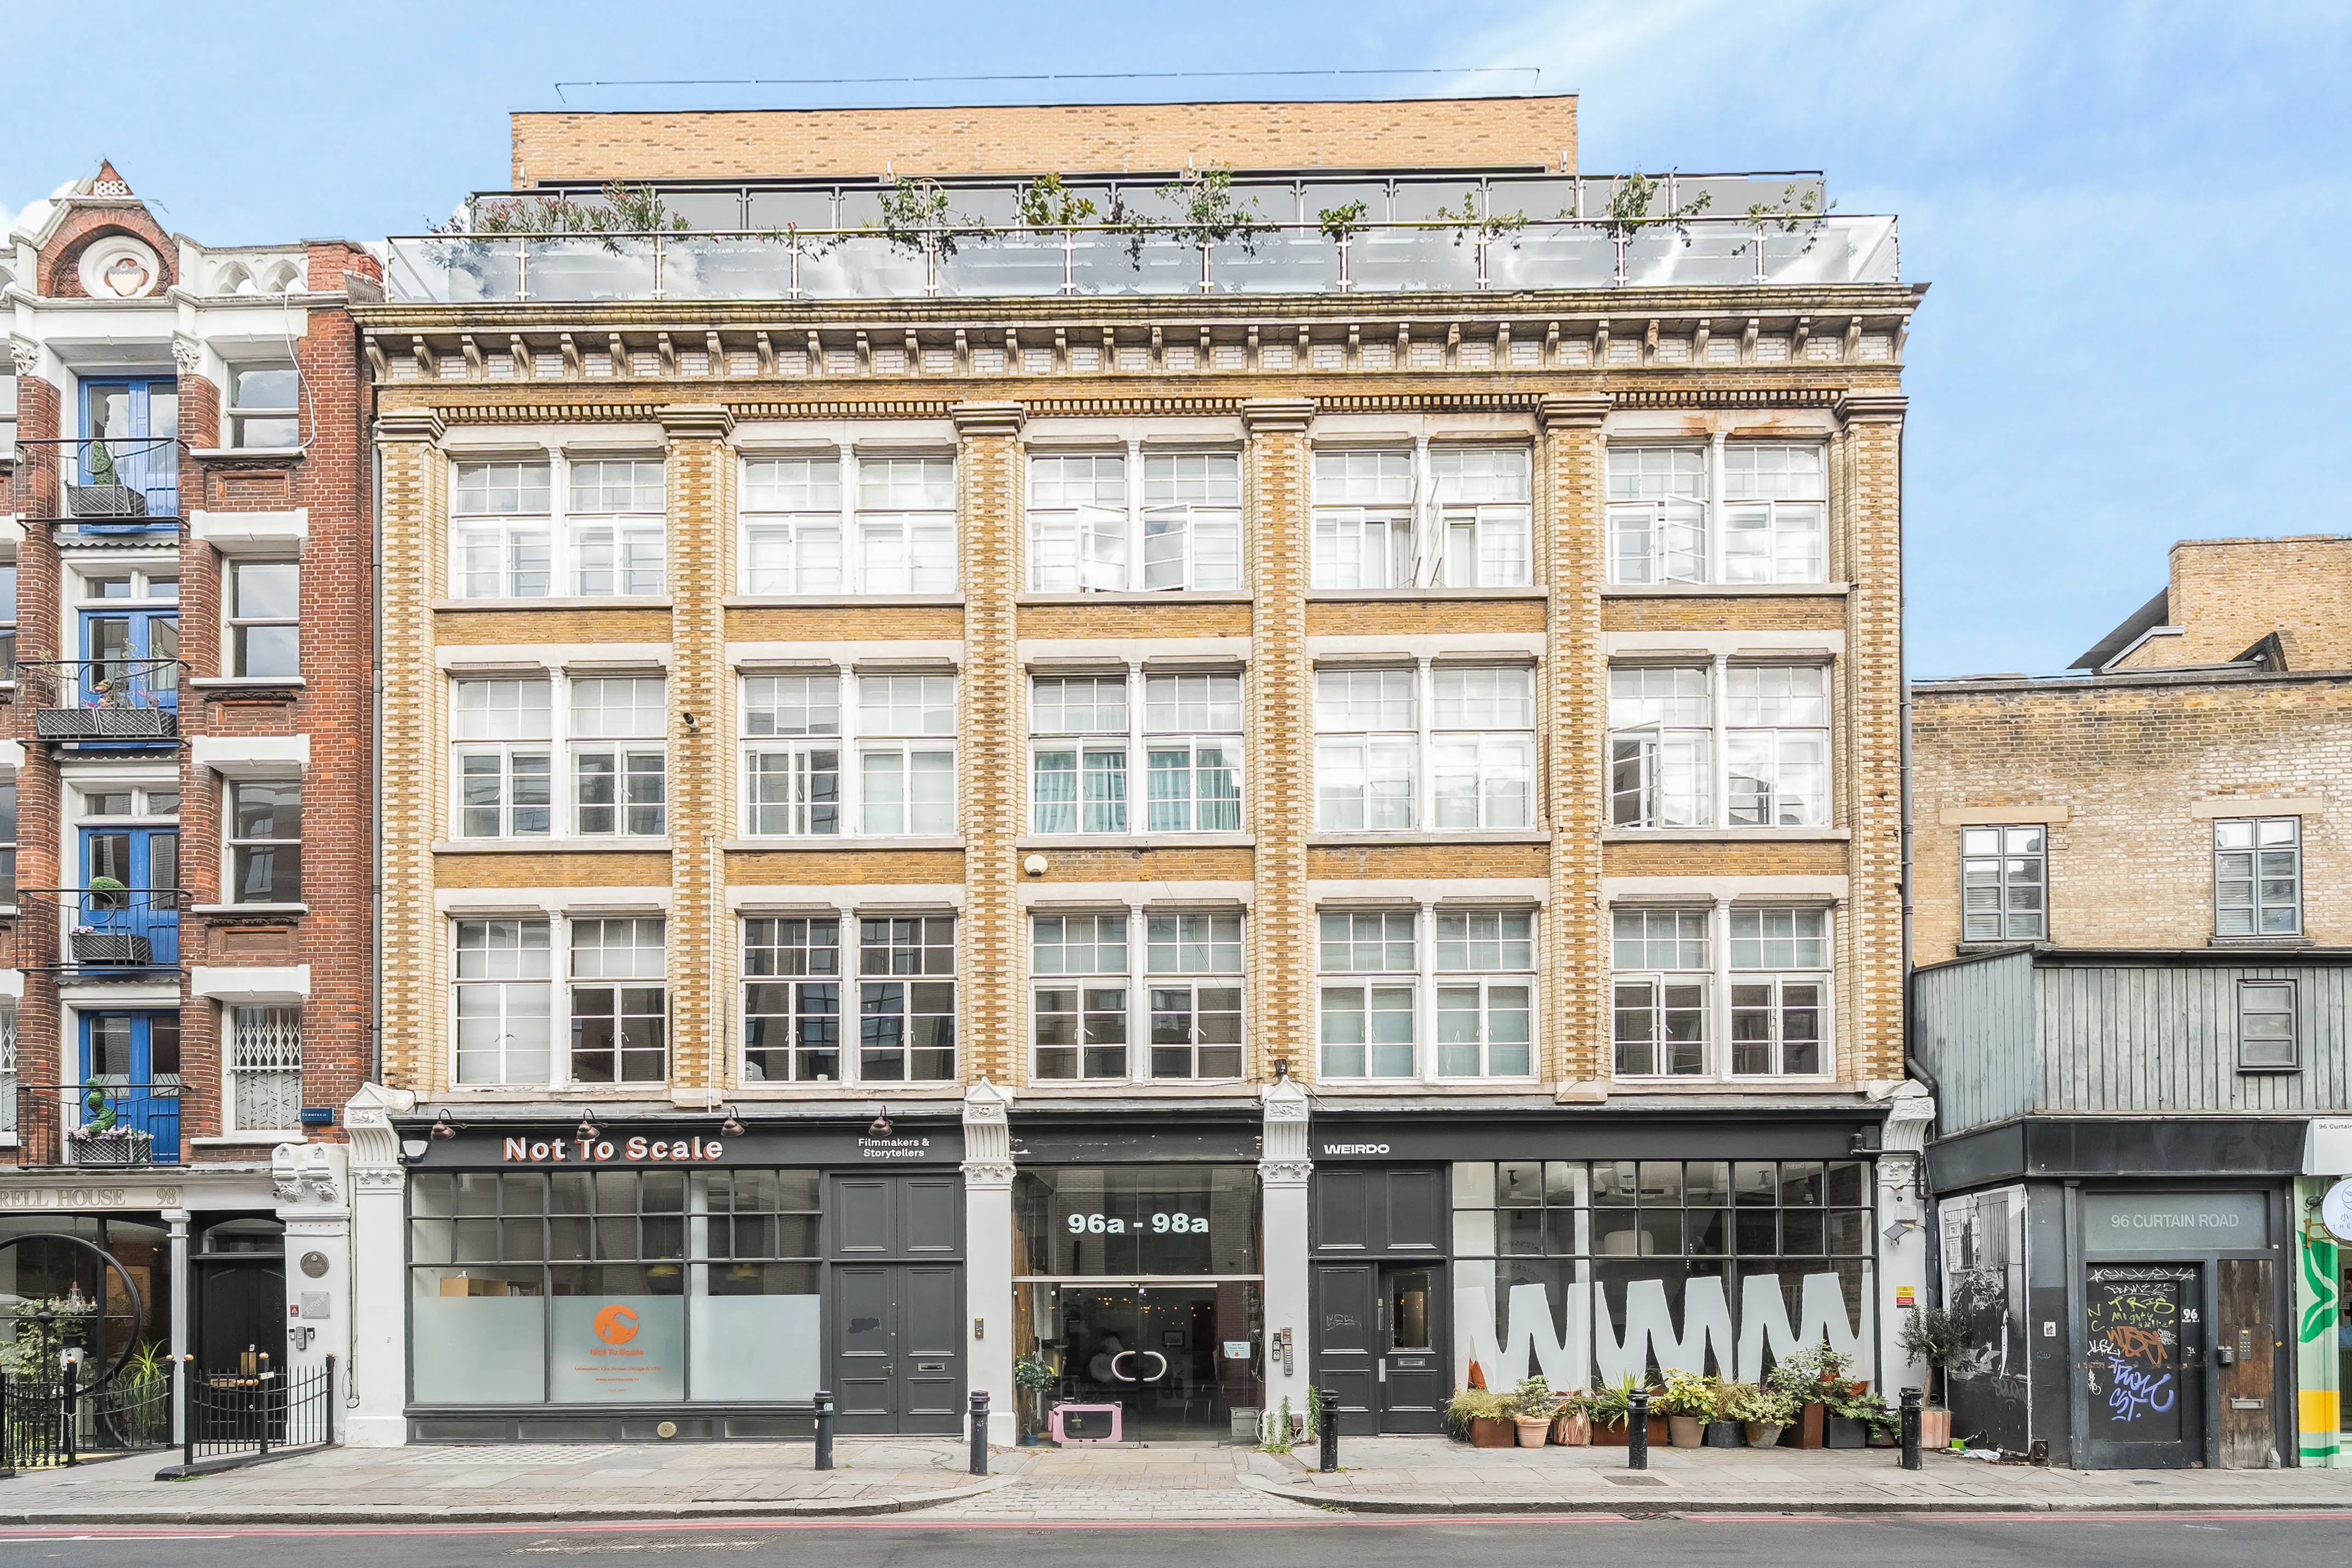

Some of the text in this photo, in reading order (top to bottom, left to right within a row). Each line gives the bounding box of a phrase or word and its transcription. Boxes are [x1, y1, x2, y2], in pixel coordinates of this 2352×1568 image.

[94, 180, 127, 196] 1883
[504, 1136, 723, 1161] Not To Scale
[858, 1138, 930, 1146] Filmmakers &
[1324, 1144, 1390, 1154] WEIRDO
[863, 1148, 924, 1158] Storytellers
[56, 1188, 125, 1206] HOUSE
[156, 1188, 177, 1205] 98
[1068, 1214, 1124, 1233] 96a
[1152, 1213, 1209, 1233] 98a
[2111, 1214, 2239, 1228] 96 CURTAIN ROAD
[2183, 1309, 2198, 1319] 96
